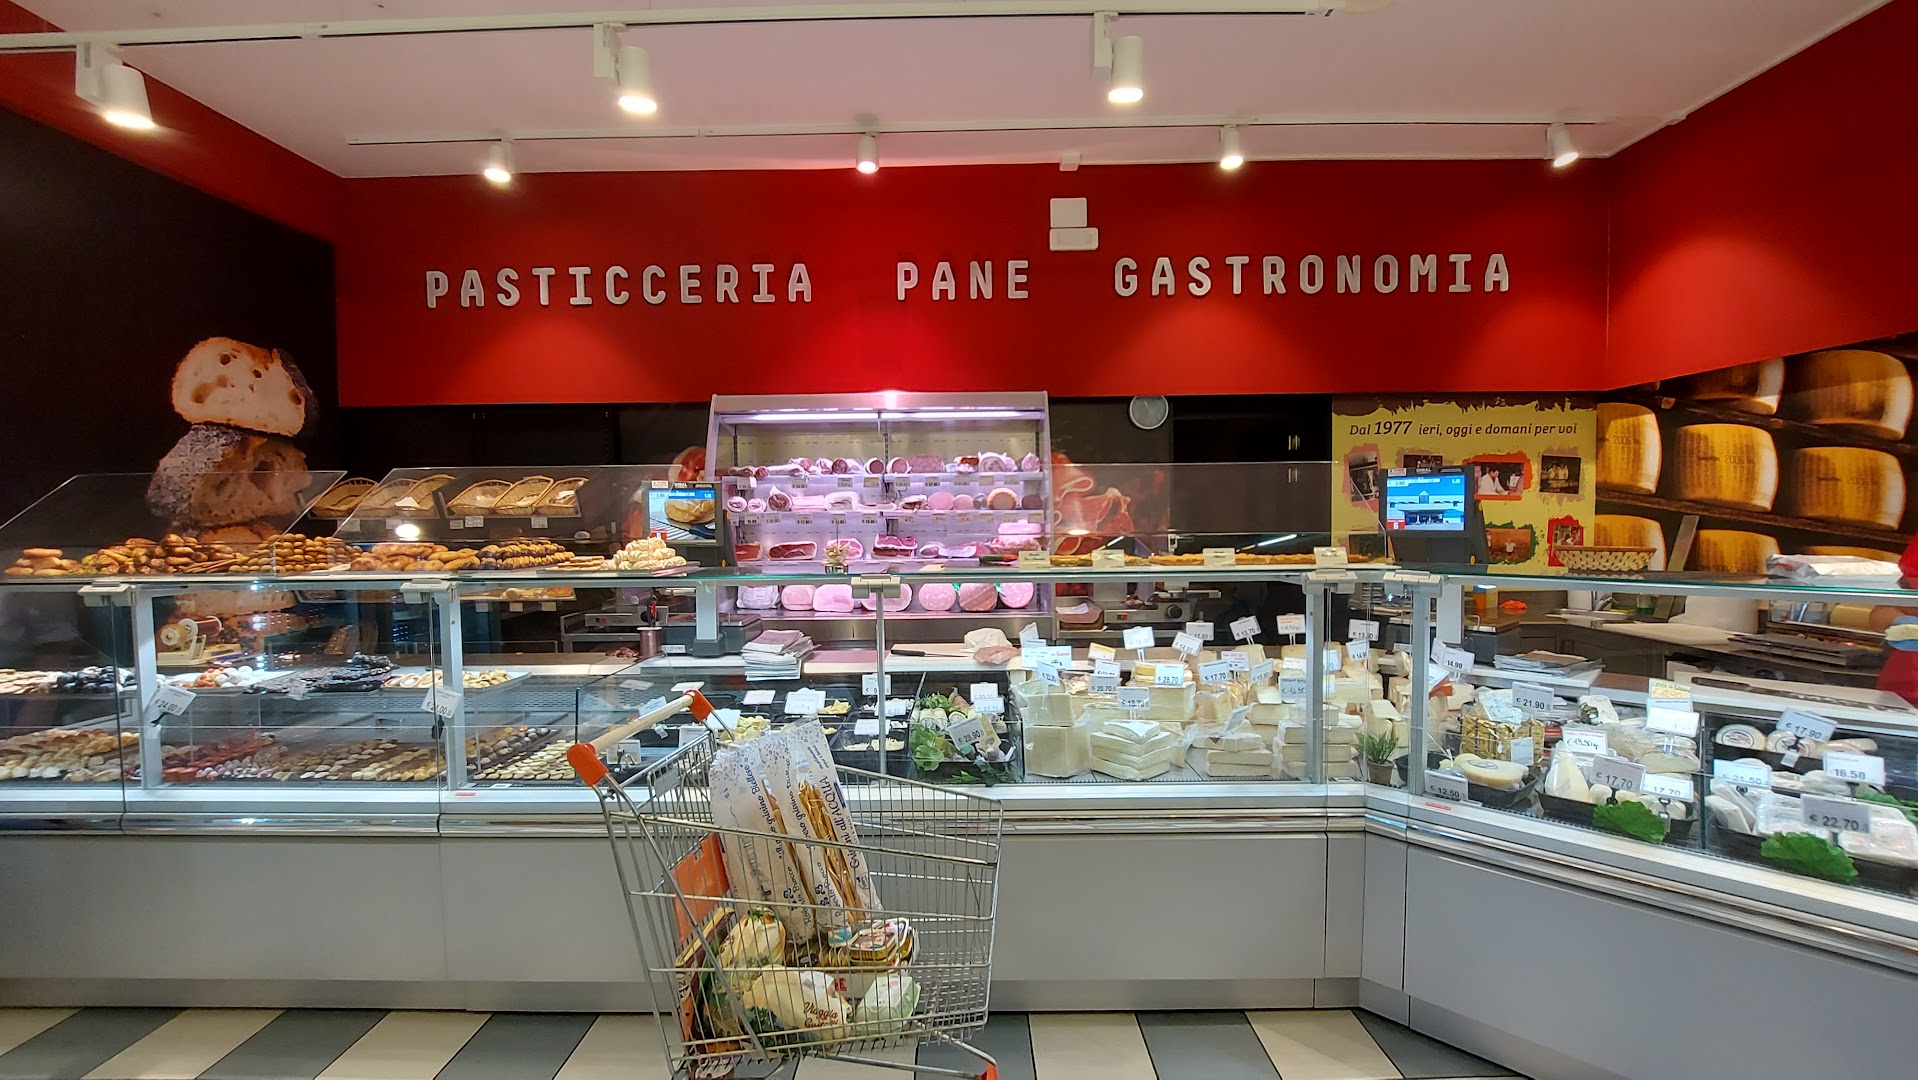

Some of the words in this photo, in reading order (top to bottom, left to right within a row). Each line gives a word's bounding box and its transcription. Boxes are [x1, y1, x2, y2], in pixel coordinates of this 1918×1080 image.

[427, 264, 811, 308] PASTICCERIA
[897, 261, 1028, 300] PANE
[1115, 254, 1508, 296] GASTRONOMIA
[1350, 424, 1371, 436] Dal
[1374, 421, 1412, 436] 1977
[1419, 424, 1443, 437] ieri,
[1446, 423, 1474, 438] oggi
[1475, 426, 1483, 435] e
[1485, 423, 1532, 435] domani
[1534, 425, 1556, 437] per
[1558, 423, 1578, 434] voi
[1613, 435, 1632, 446] 2006
[1447, 660, 1463, 669] 14.90
[1163, 676, 1179, 684] 28.70
[1210, 672, 1227, 681] 17.70
[158, 701, 178, 712] 24.00
[1523, 698, 1545, 710] 21.90
[964, 730, 981, 743] 23.90
[1795, 725, 1822, 739] 17.90
[1596, 771, 1602, 779] €
[1606, 775, 1633, 789] 17.70
[1734, 775, 1762, 785] 21.50
[1834, 768, 1866, 780] 16.50
[1438, 786, 1460, 798] 12.50
[755, 793, 774, 825] grissino
[787, 789, 805, 820] grissino
[818, 775, 846, 832] all'ACQUA
[1809, 814, 1818, 822] €
[1822, 816, 1859, 831] 22.70
[785, 866, 799, 892] Brocco
